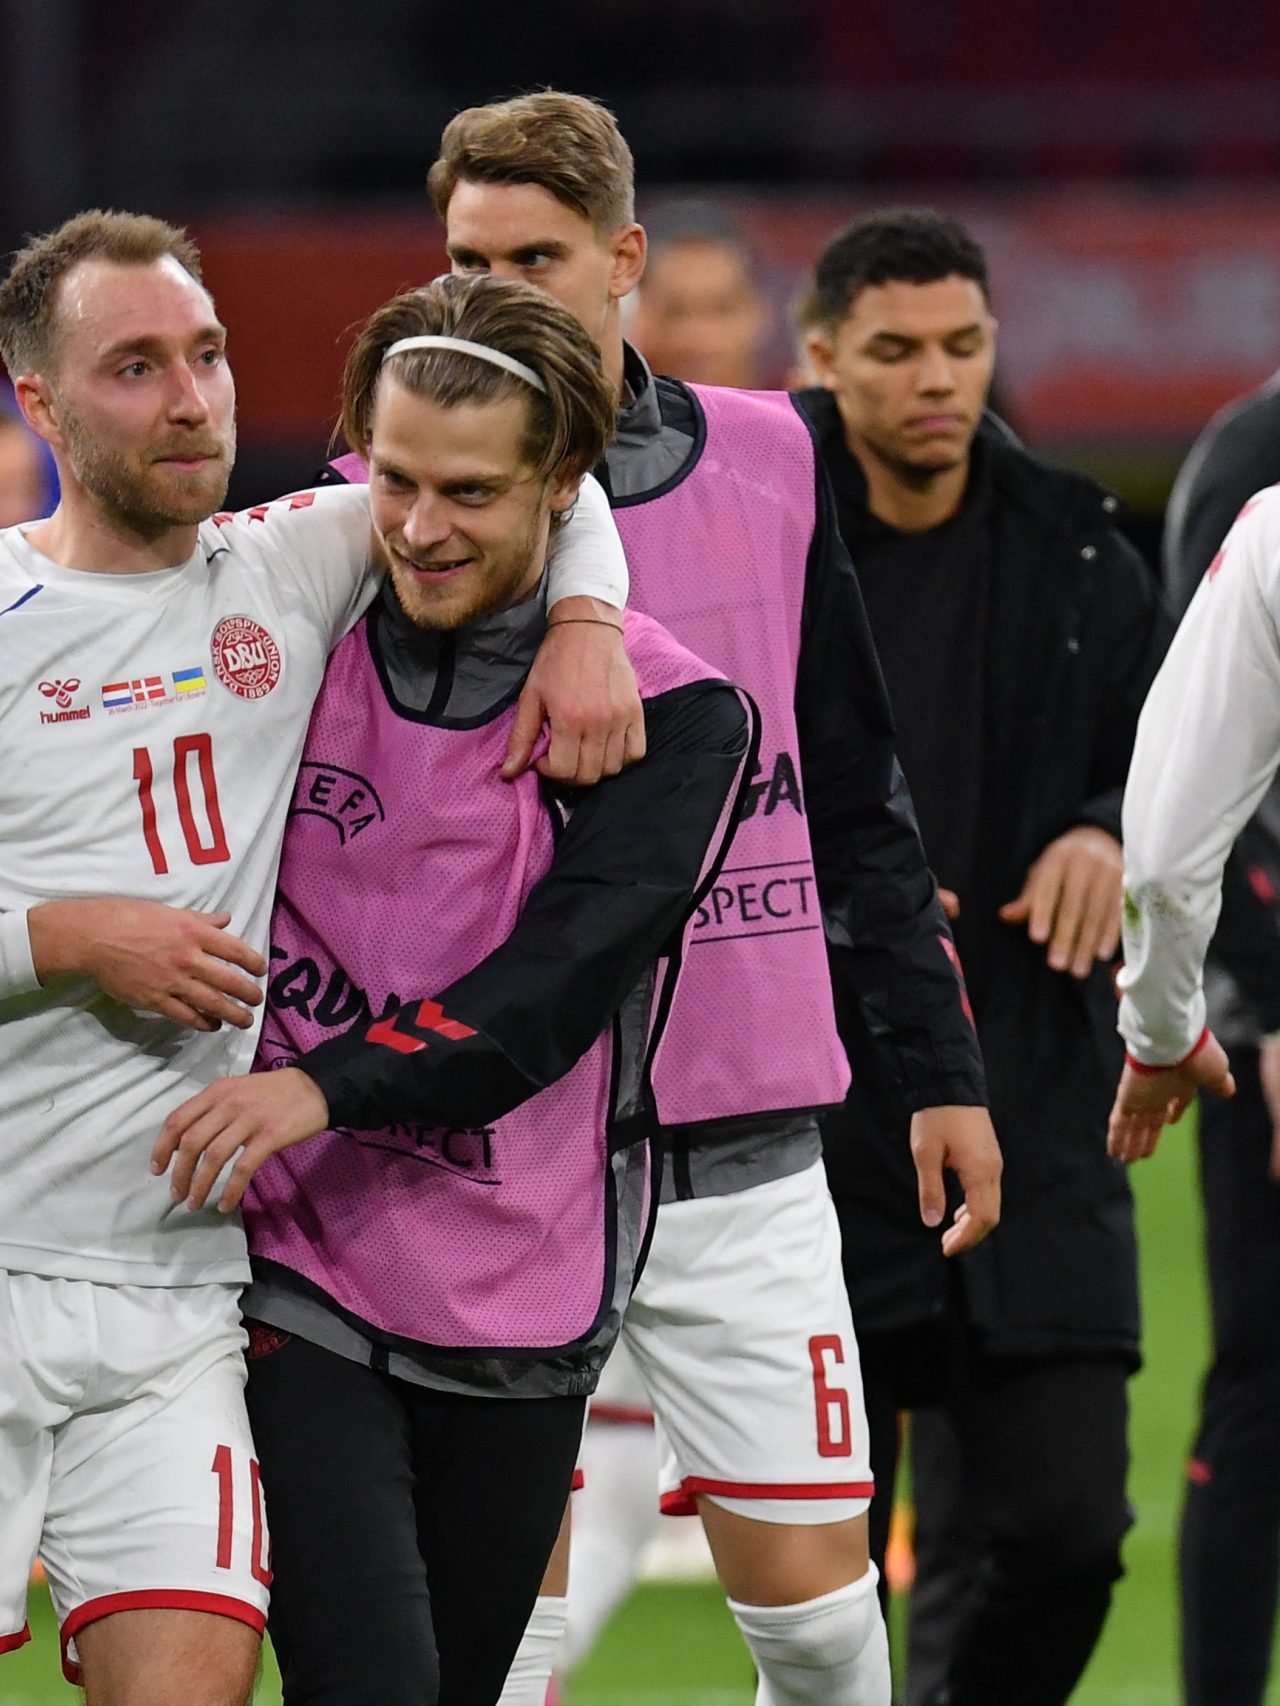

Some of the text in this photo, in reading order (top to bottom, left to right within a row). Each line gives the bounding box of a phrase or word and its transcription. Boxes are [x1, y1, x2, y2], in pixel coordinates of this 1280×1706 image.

[223, 641, 268, 672] DBU
[40, 705, 90, 724] hummel
[133, 732, 231, 875] 10
[309, 774, 376, 840] EFA
[694, 876, 813, 929] SPECT
[808, 1334, 852, 1457] 6
